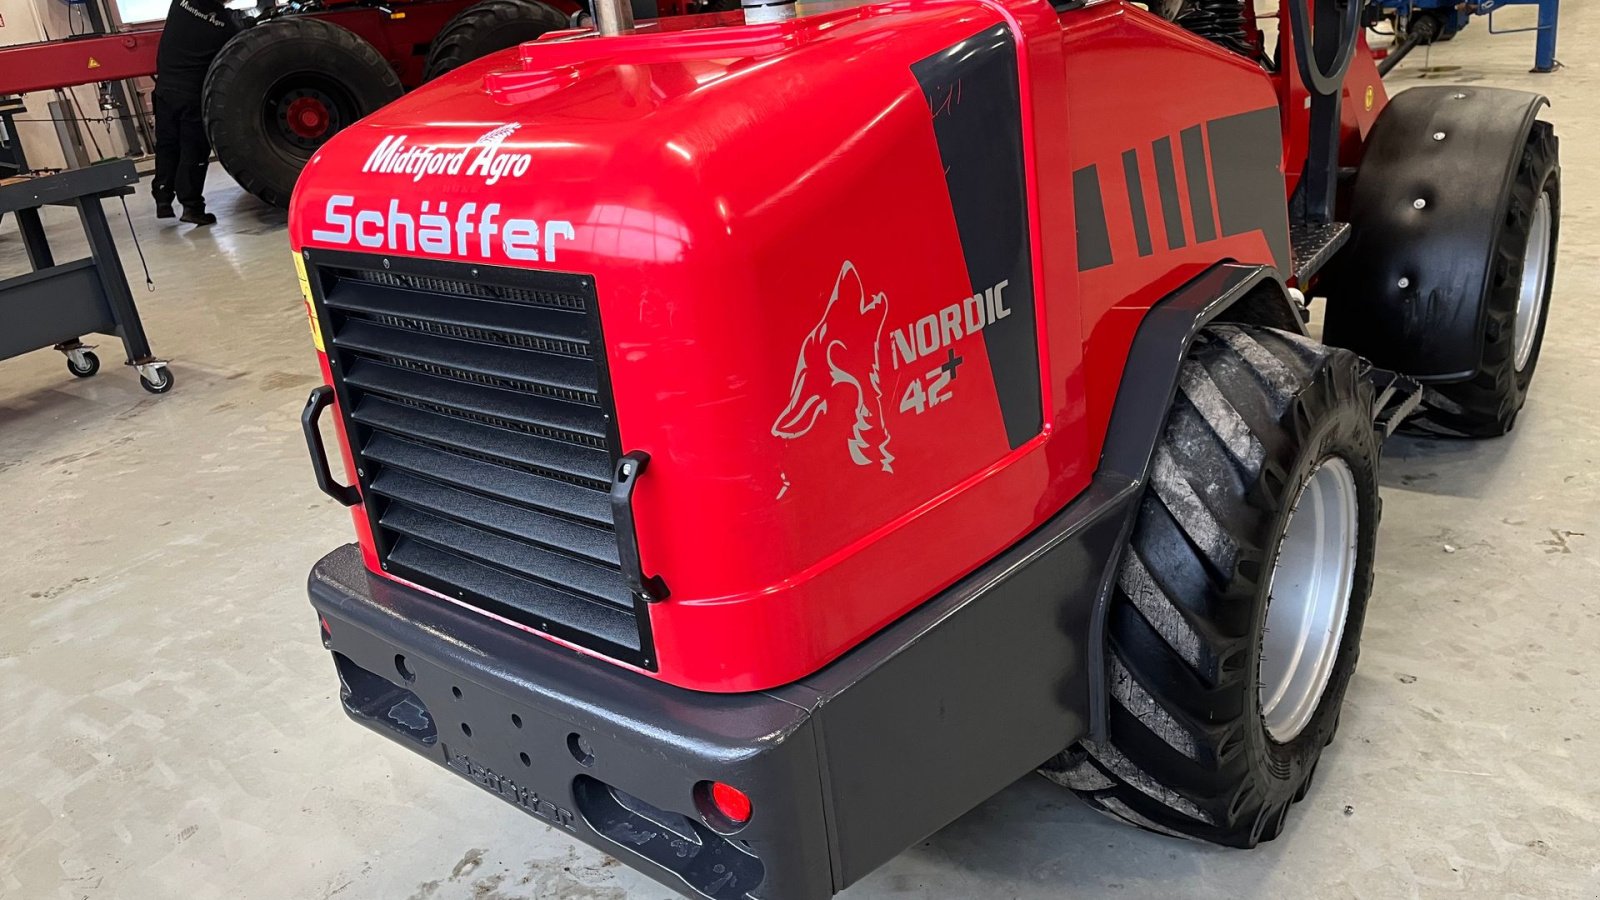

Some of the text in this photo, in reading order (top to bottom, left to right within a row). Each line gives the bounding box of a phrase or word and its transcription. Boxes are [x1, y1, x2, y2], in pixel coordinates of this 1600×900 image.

[209, 13, 225, 27] Agro
[362, 123, 532, 185] Midtfjord Agro
[312, 194, 576, 263] Schäffer
[890, 279, 1012, 371] NORDIC
